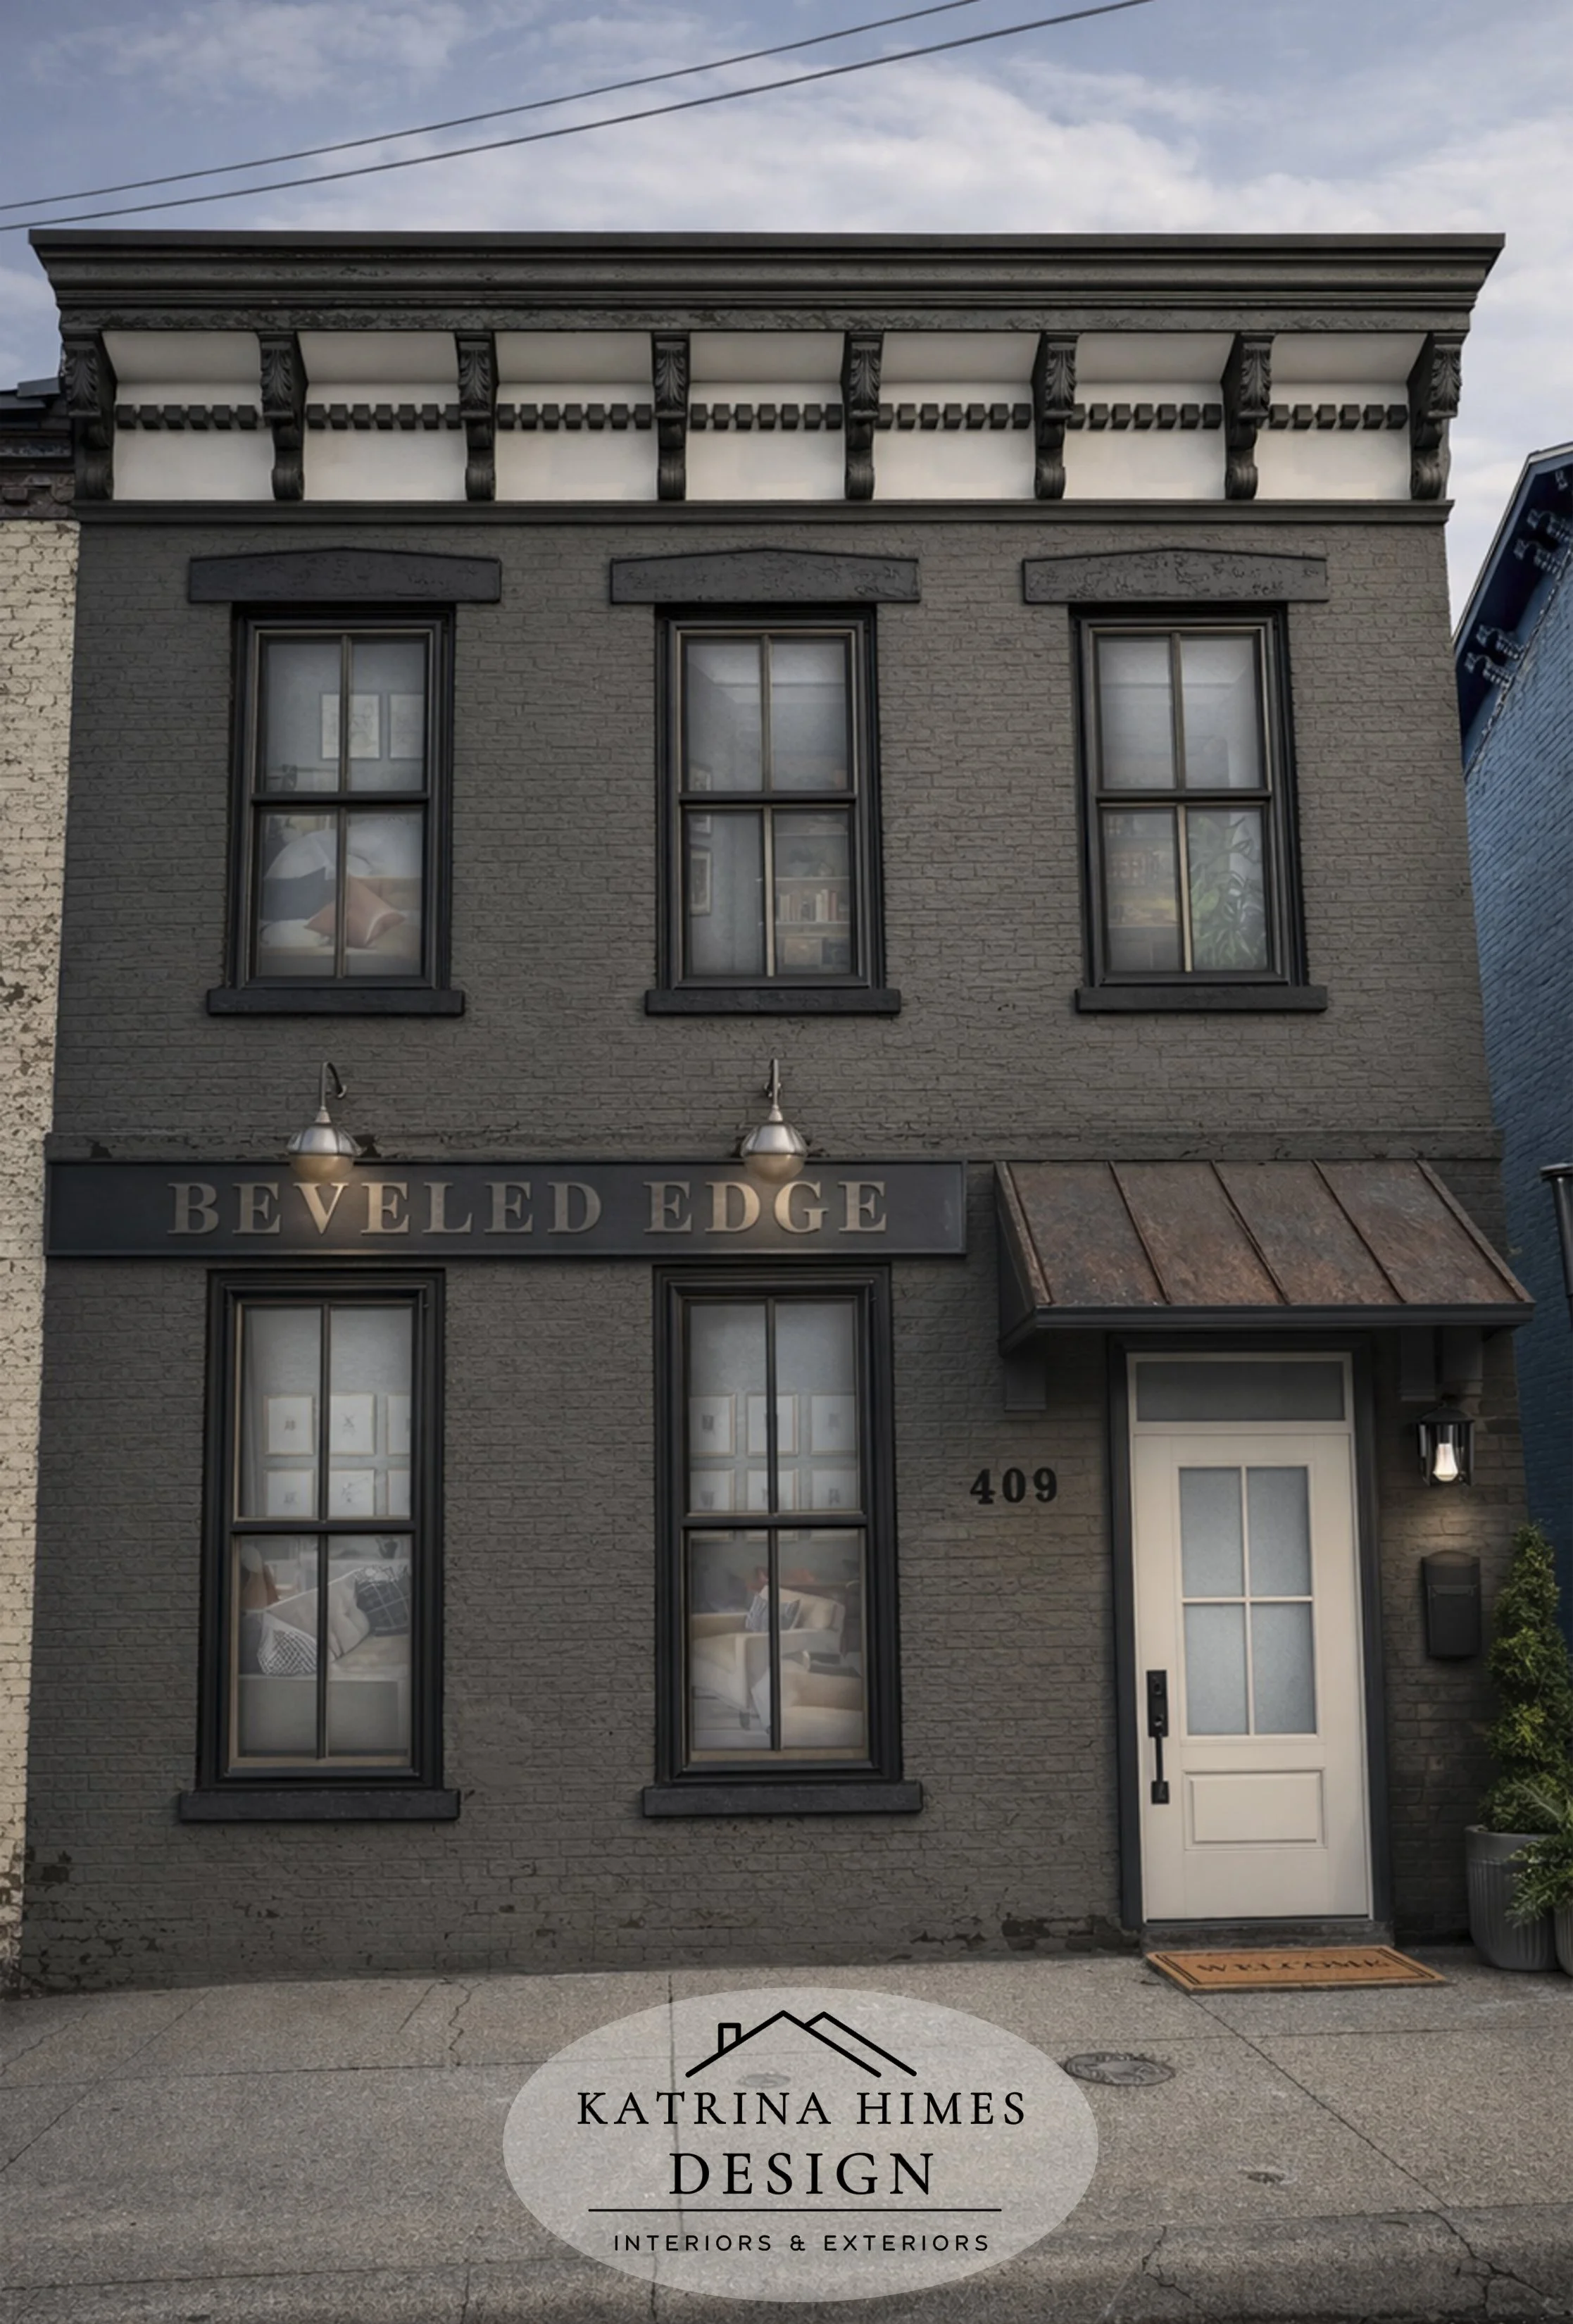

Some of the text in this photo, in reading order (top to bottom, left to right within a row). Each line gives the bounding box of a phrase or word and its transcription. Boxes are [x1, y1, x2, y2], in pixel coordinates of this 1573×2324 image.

[167, 1181, 887, 1235] BEVELED EDGE
[970, 1467, 1057, 1504] 409
